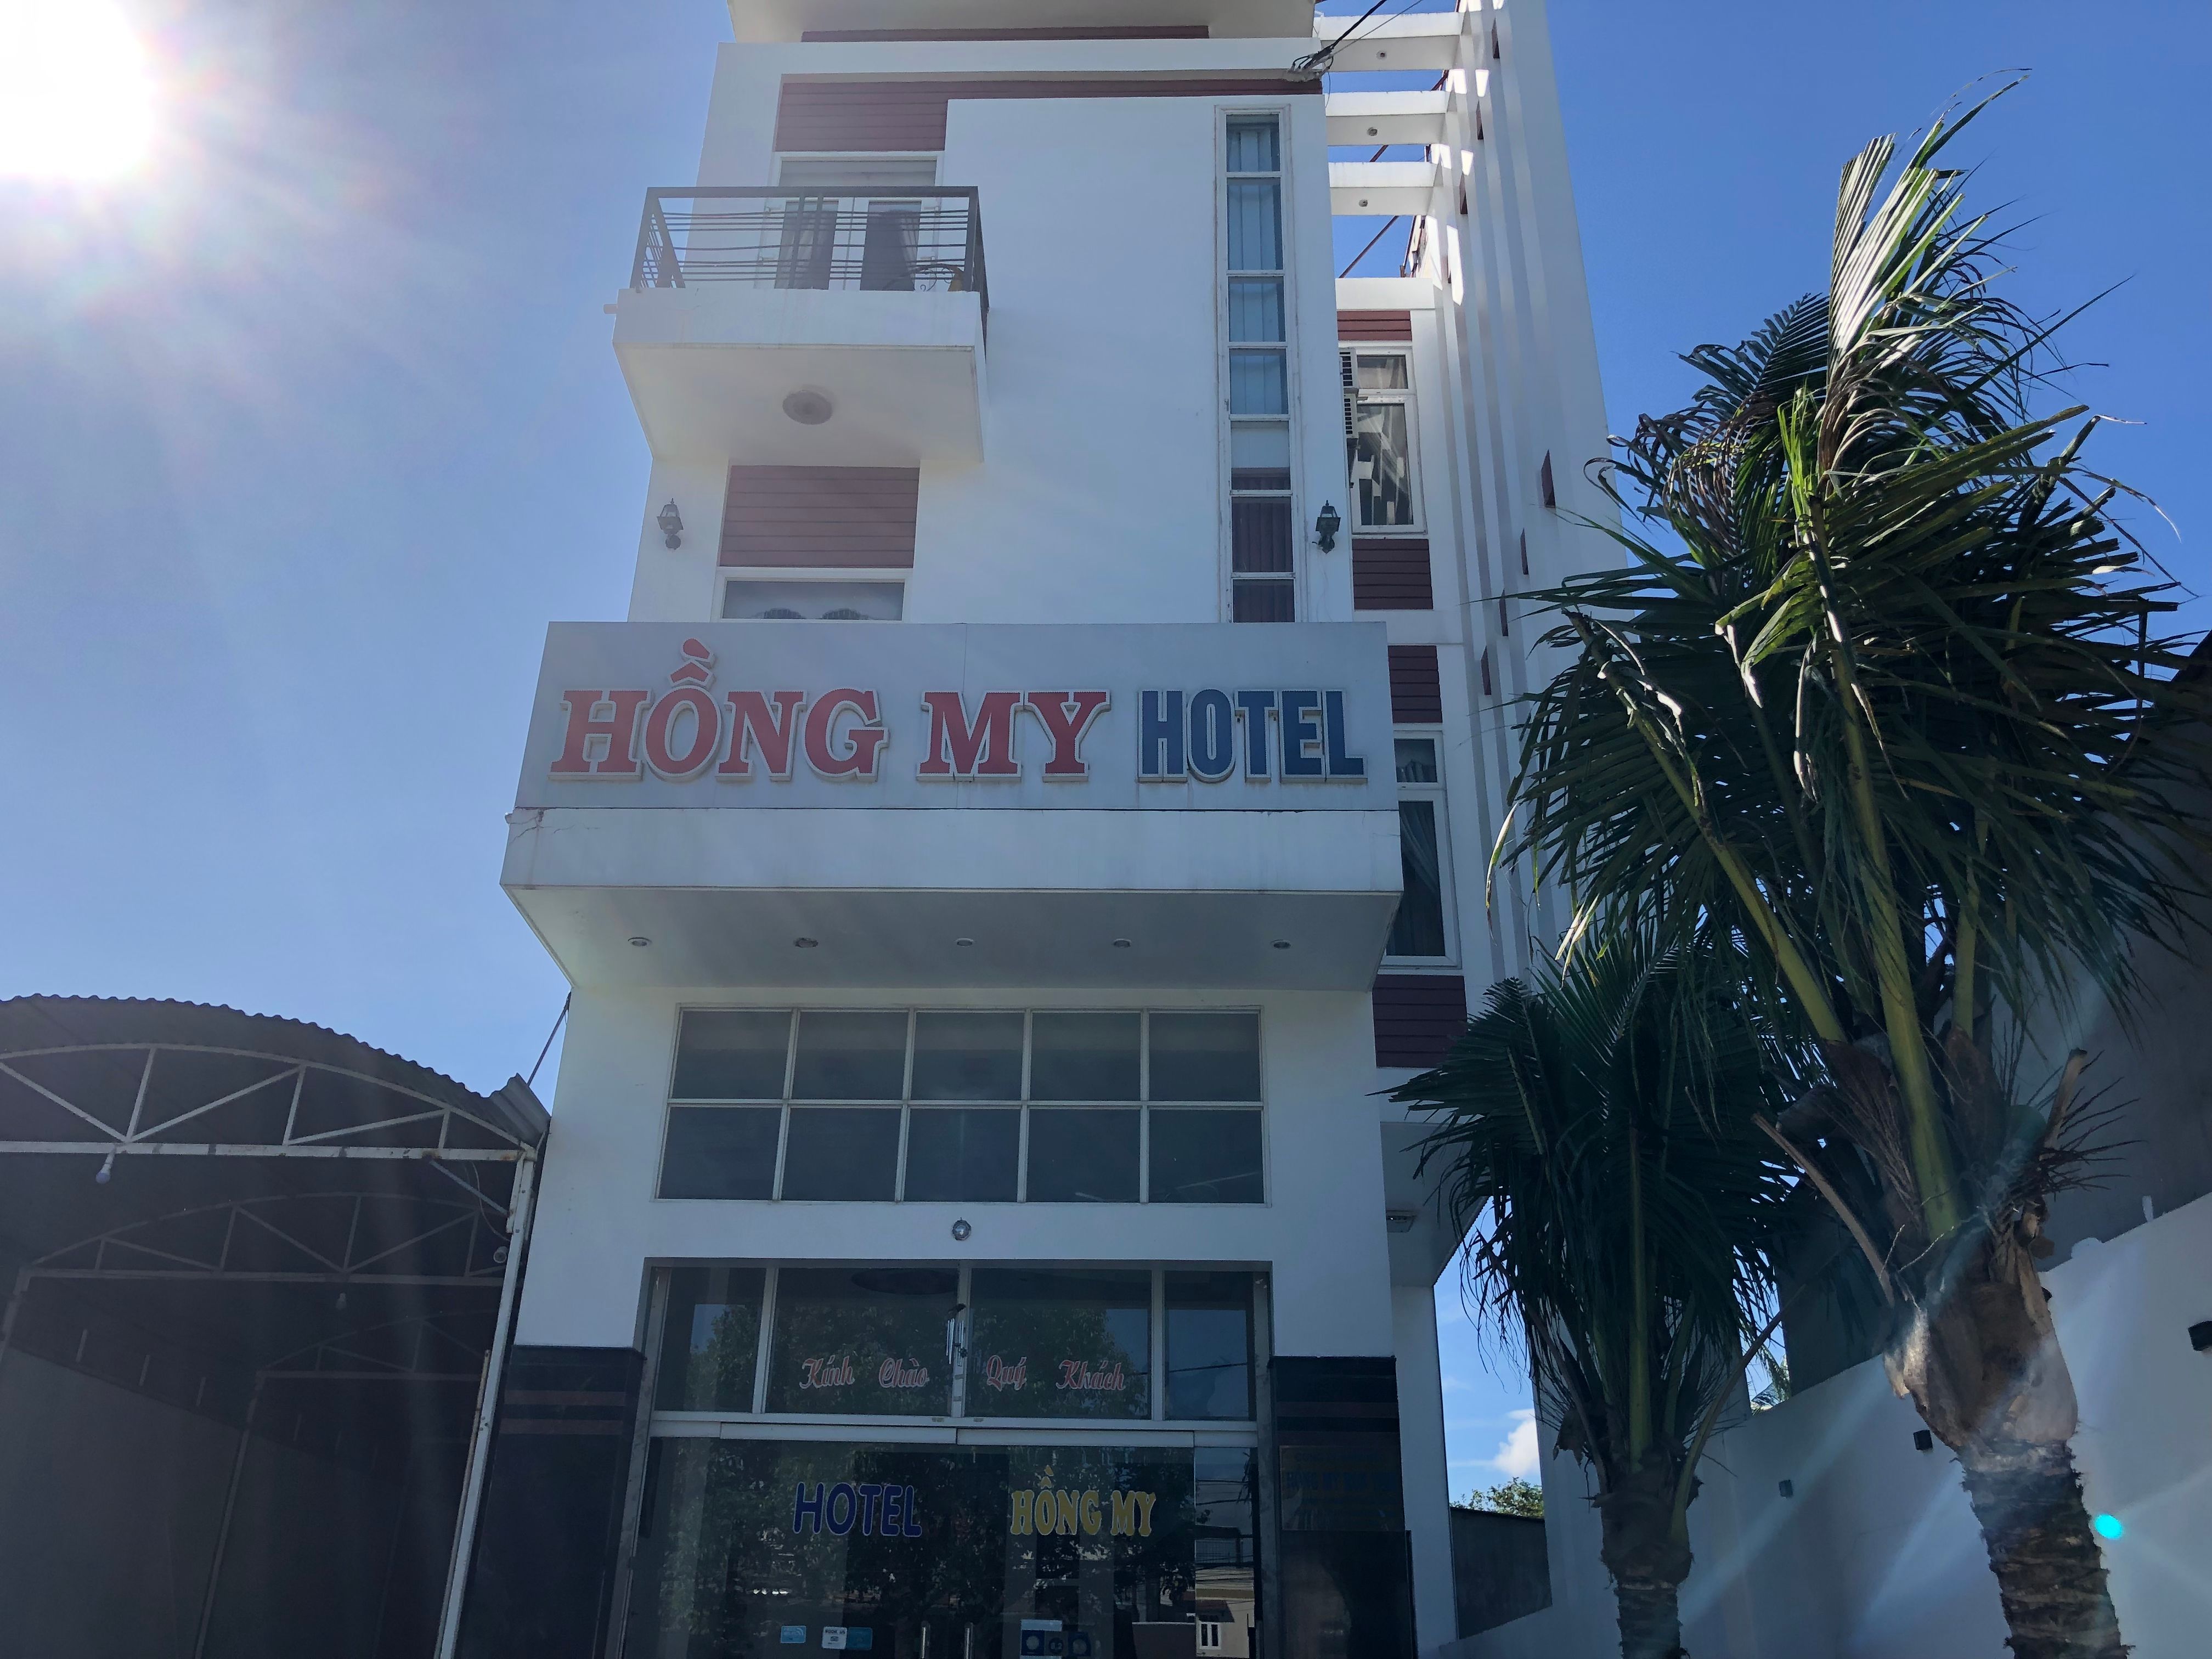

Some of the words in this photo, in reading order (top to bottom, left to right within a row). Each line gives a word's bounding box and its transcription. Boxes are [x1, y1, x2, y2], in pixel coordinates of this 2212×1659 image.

[549, 637, 887, 782] HỒNG
[917, 690, 1111, 782] MY
[1136, 690, 1368, 783] HOTEL
[799, 1355, 855, 1389] Kính
[878, 1357, 929, 1389] Chào
[987, 1354, 1026, 1391] Quý
[1056, 1359, 1126, 1391] Khách
[793, 1482, 922, 1537] HOTEL
[1010, 1465, 1102, 1535] HỒNG
[1111, 1490, 1156, 1536] MY
